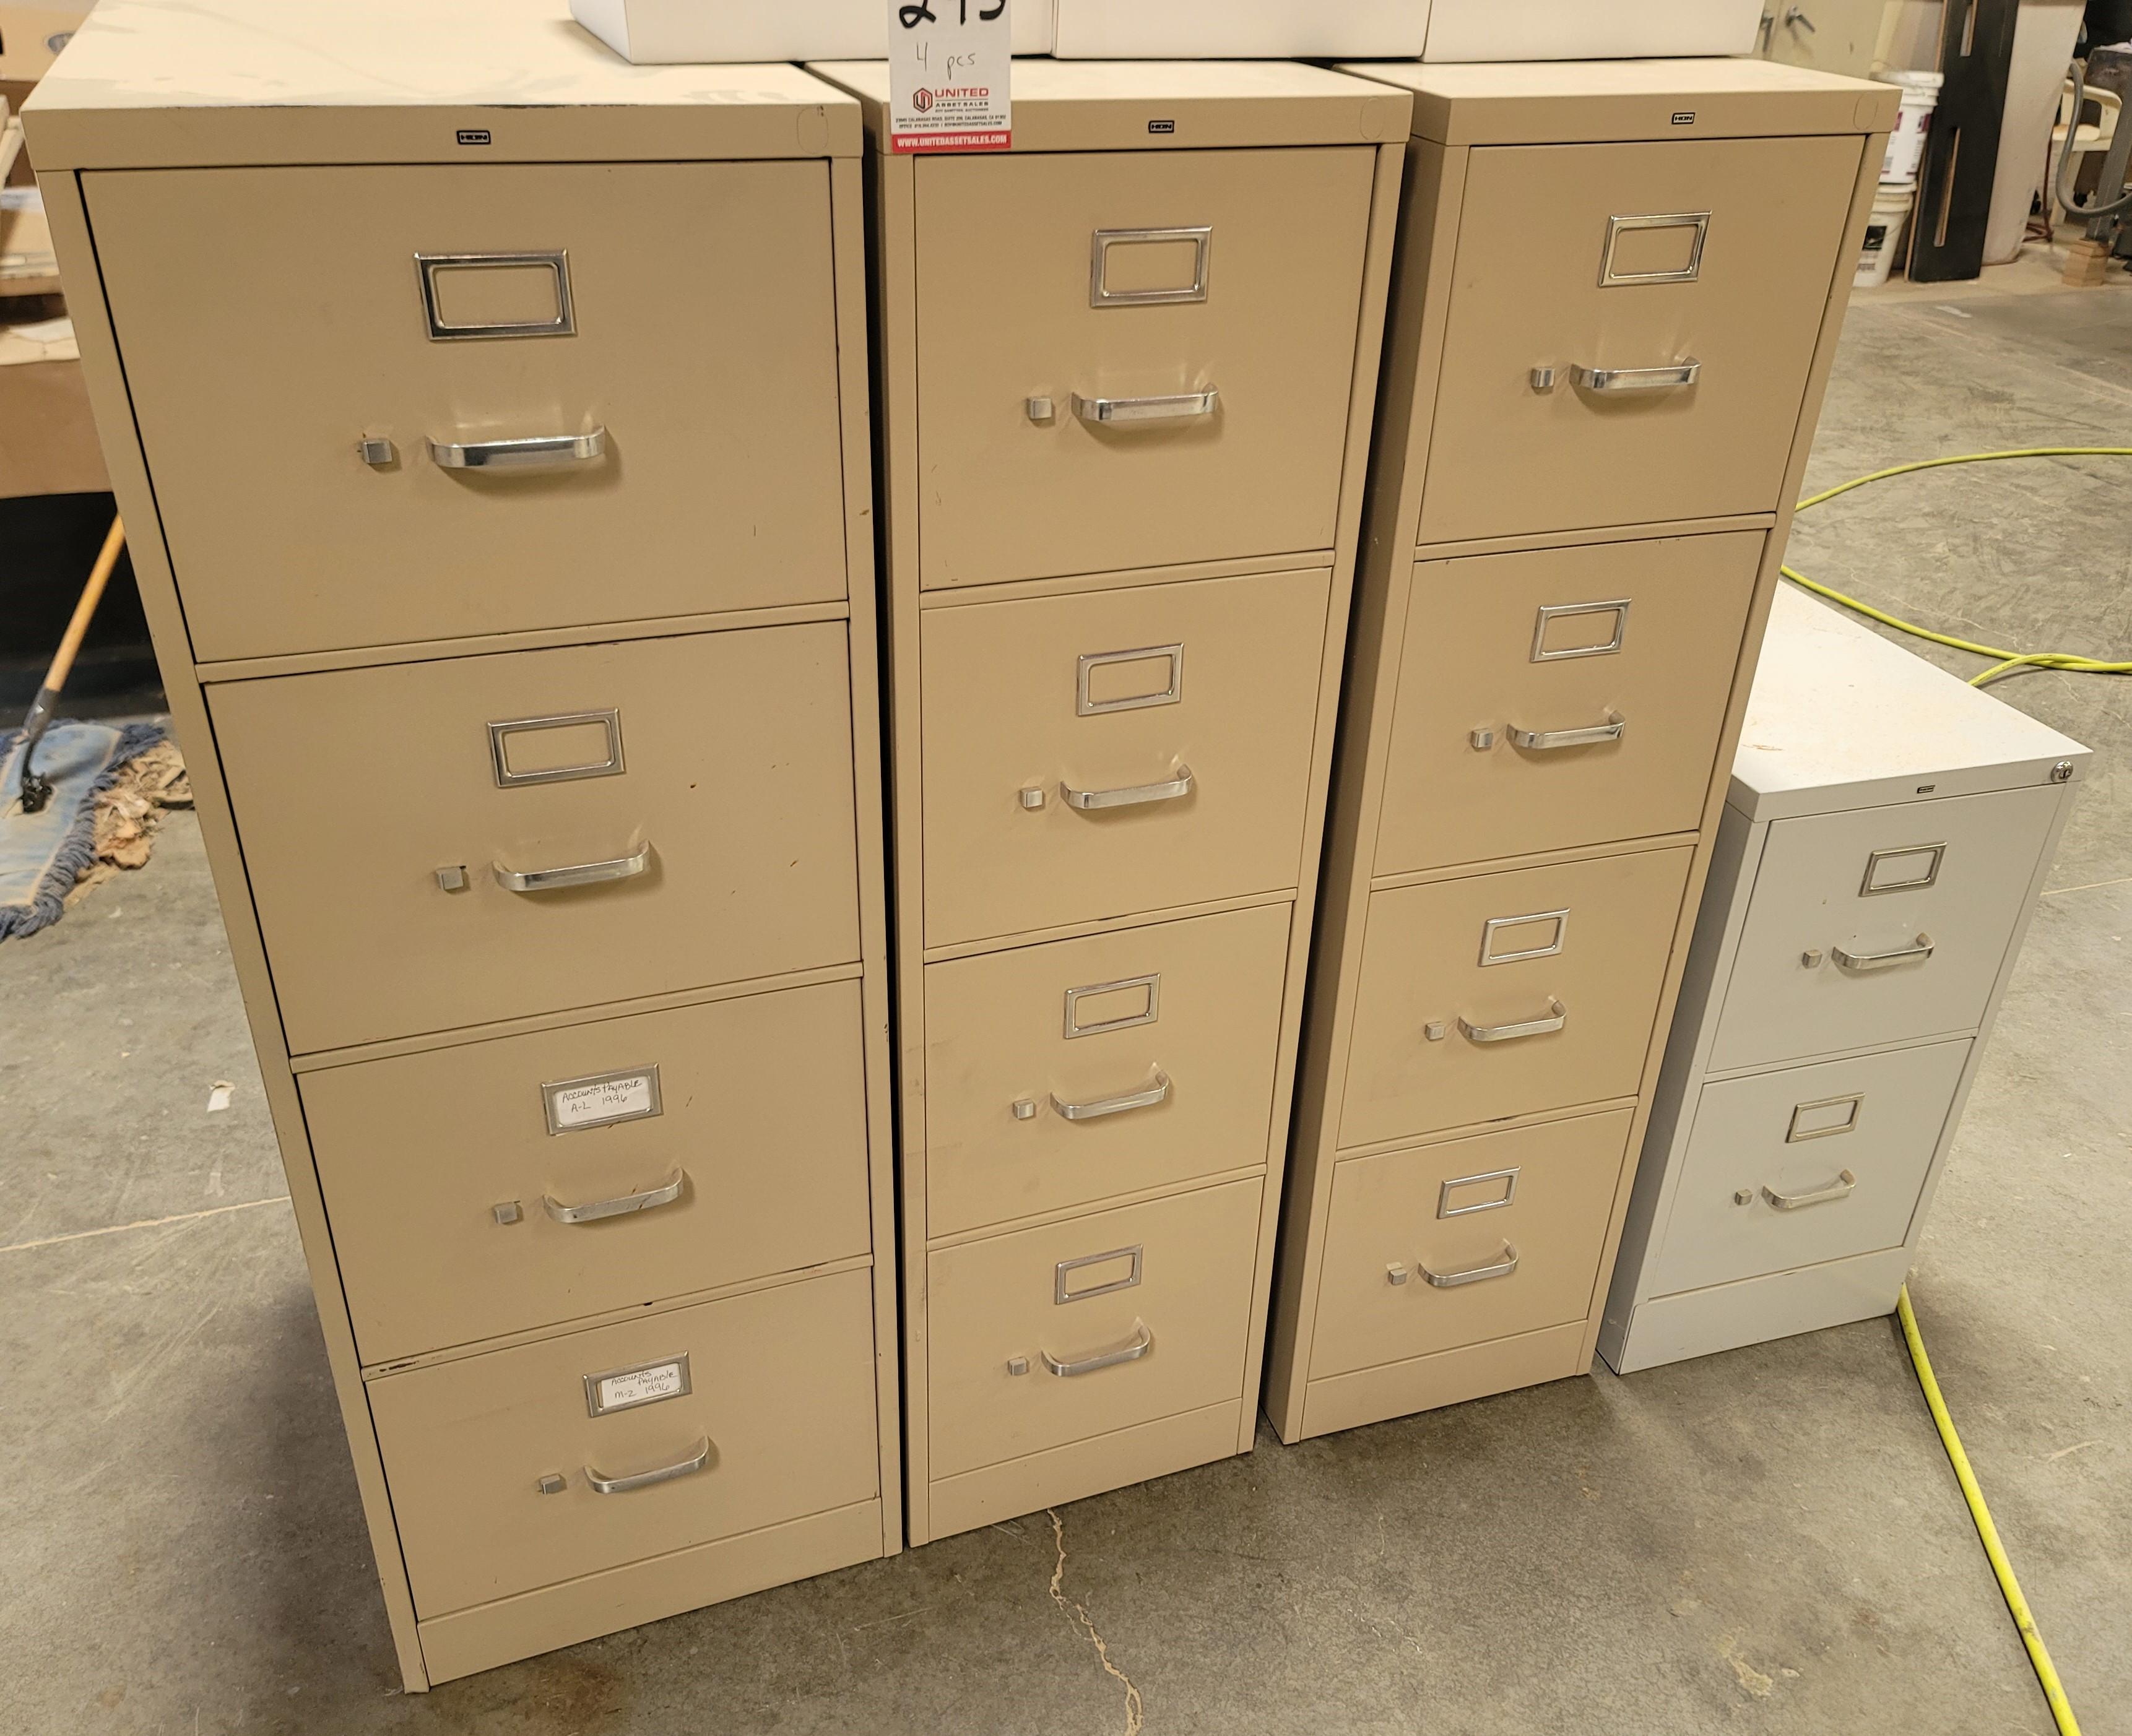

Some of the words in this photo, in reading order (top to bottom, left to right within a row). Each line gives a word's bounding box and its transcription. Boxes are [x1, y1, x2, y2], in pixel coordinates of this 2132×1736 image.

[916, 41, 928, 72] 4
[947, 52, 976, 80] pcs
[935, 88, 989, 97] UNITED
[897, 134, 1007, 148] WWW.UNITEDASSETSALES.COM
[571, 1102, 592, 1113] A-L
[602, 1094, 628, 1105] 1996
[645, 1383, 670, 1394] 1996
